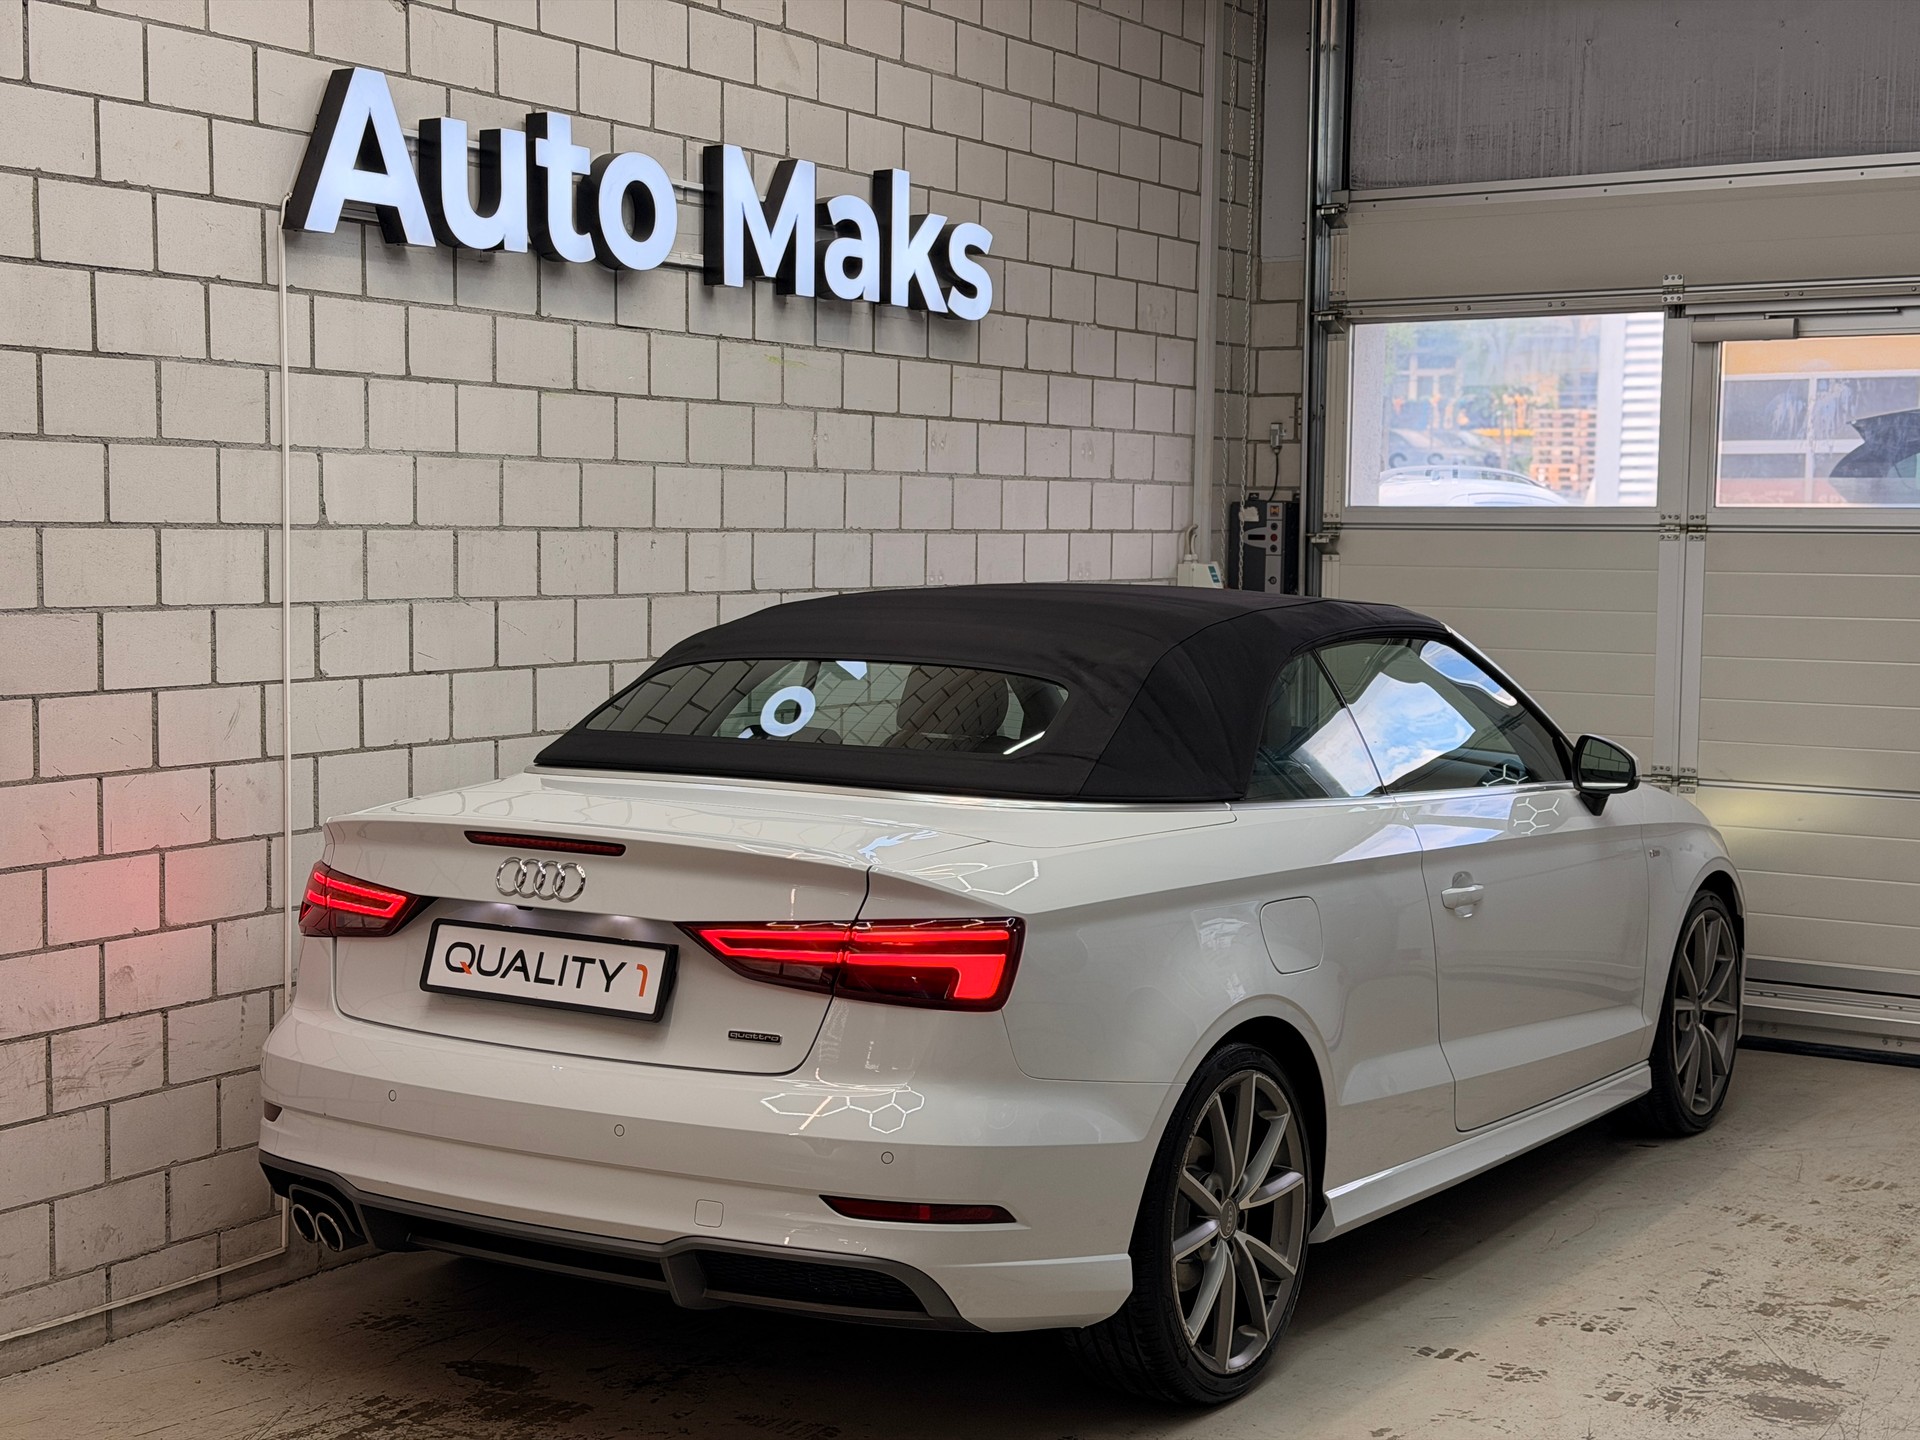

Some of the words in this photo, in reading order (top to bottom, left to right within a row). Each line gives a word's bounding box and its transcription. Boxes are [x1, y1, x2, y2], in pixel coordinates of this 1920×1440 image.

[303, 67, 677, 271] Auto
[722, 144, 993, 321] Maks
[445, 941, 627, 992] QUALITY
[730, 1032, 779, 1042] quattro
